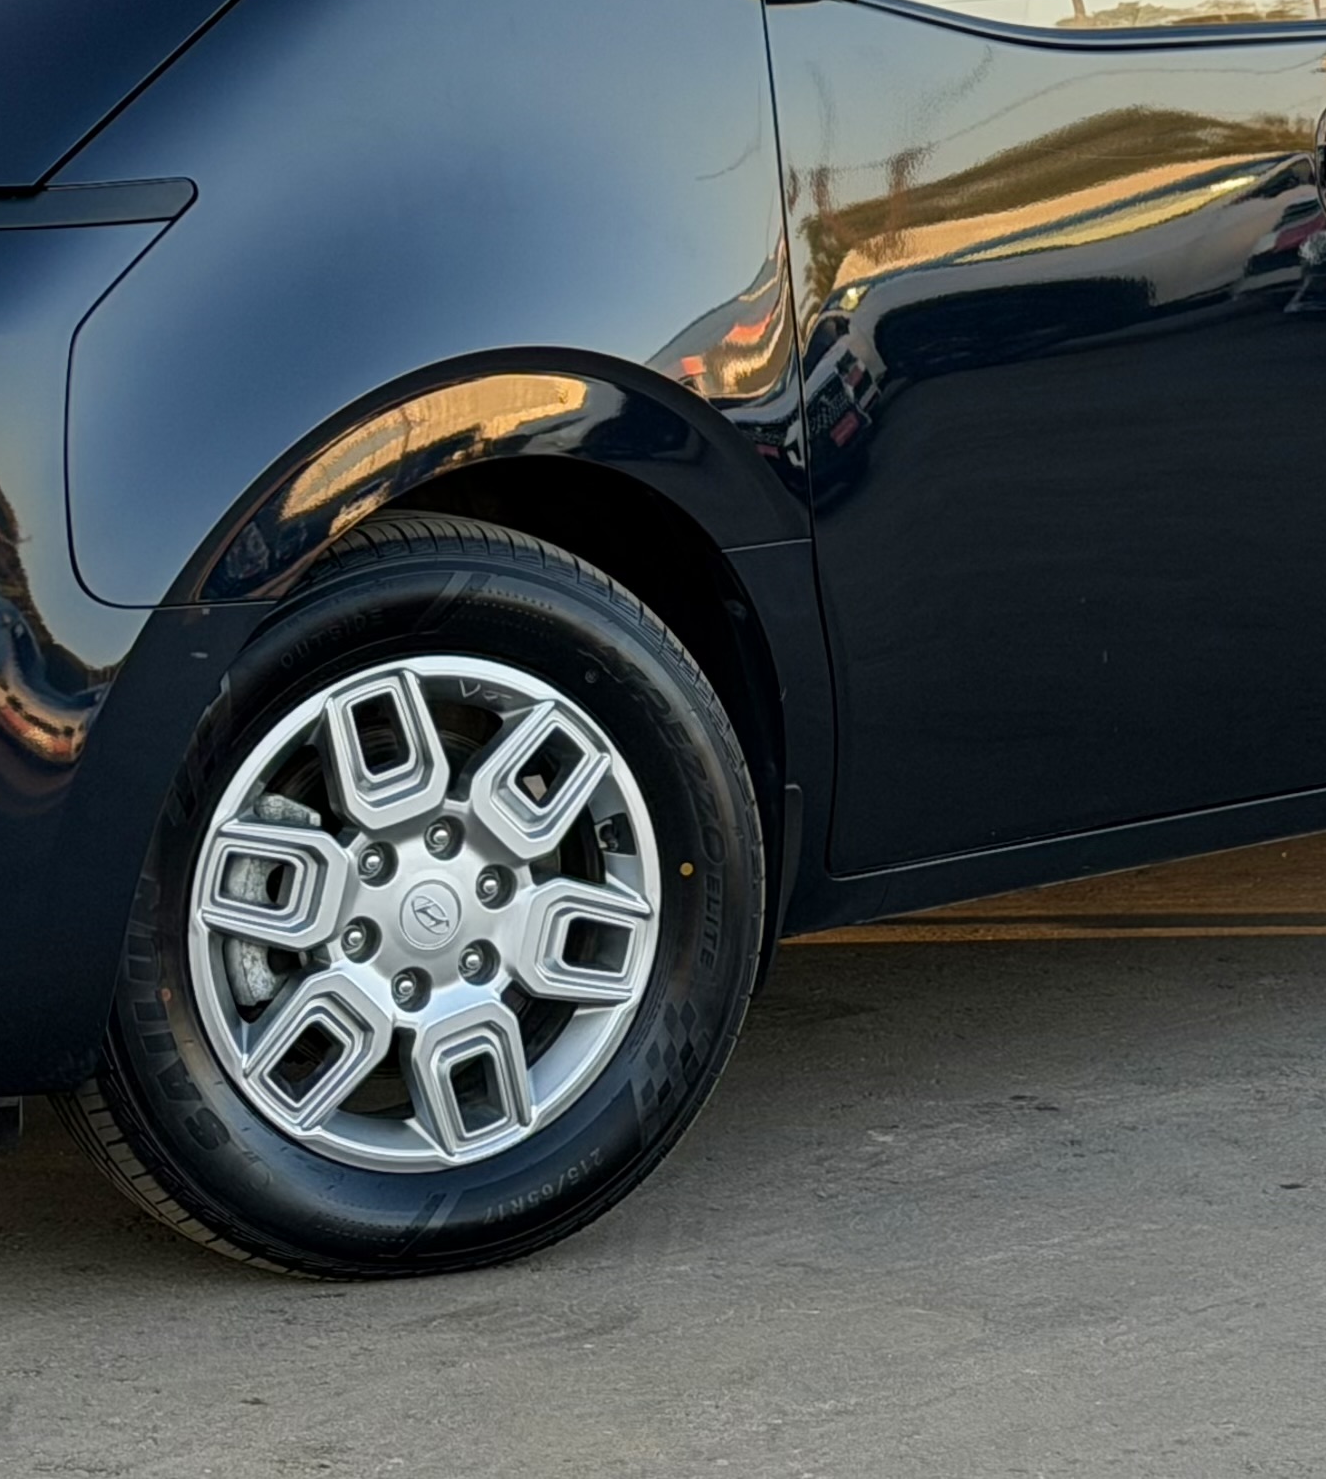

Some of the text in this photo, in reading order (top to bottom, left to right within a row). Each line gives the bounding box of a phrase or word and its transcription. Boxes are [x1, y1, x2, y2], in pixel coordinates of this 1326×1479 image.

[280, 607, 385, 668] OUTSIDE
[699, 873, 723, 970] ELITE
[124, 876, 231, 1154] SAILUN
[483, 1147, 604, 1223] 215/65R17
